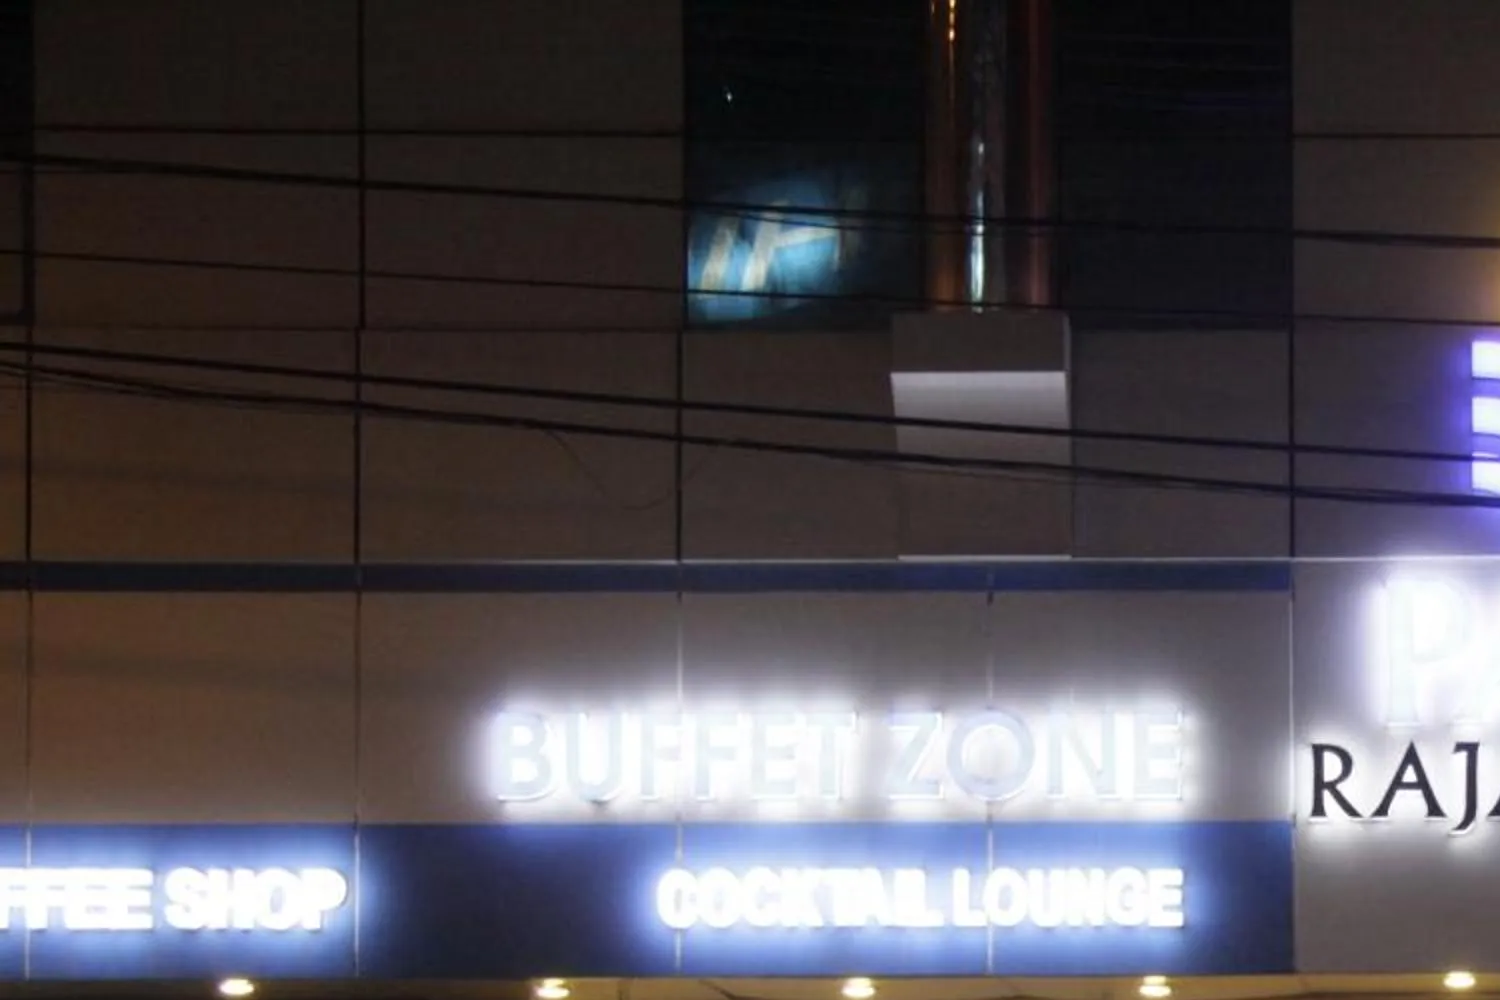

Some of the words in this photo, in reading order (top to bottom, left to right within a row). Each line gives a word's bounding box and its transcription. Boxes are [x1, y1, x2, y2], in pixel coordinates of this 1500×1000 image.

[498, 710, 860, 802] BUFFET
[888, 709, 1184, 801] ZONE
[163, 867, 348, 930] SHOP
[655, 867, 946, 929] COCKTAIL
[952, 867, 1185, 928] LOUNGE
